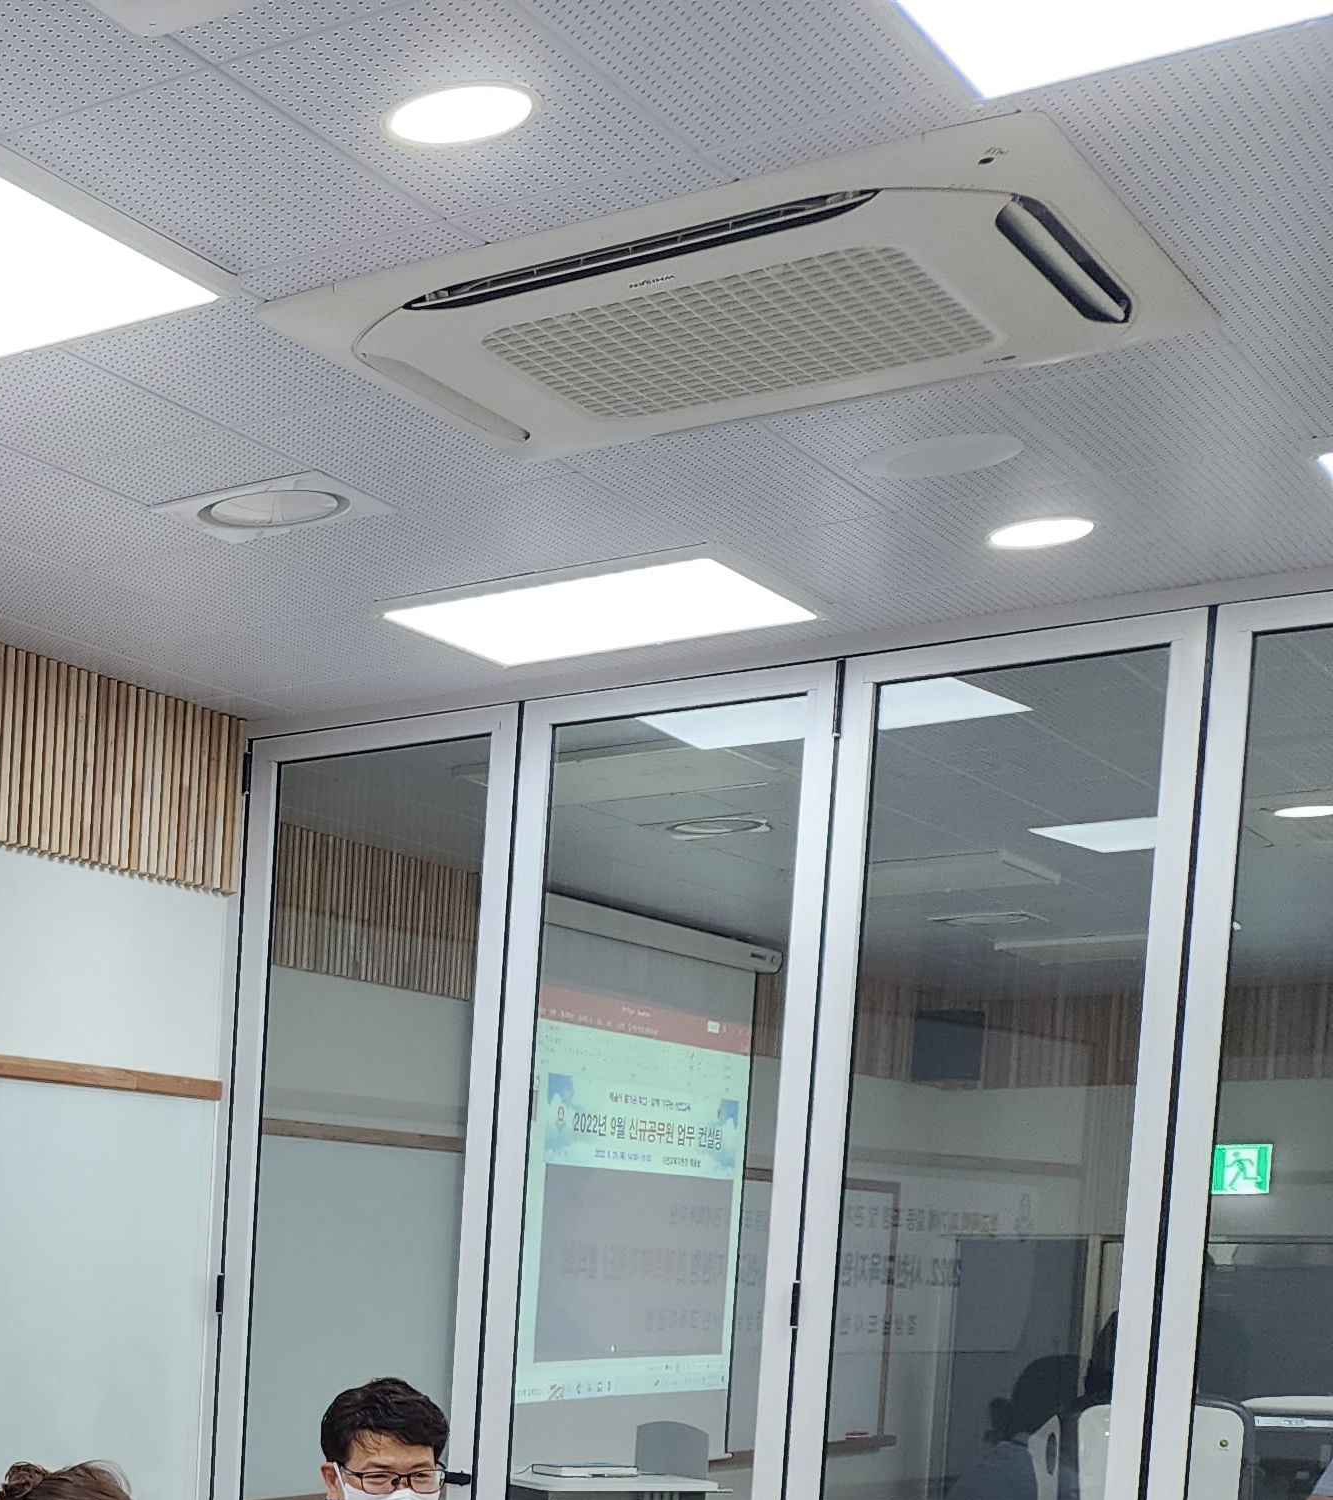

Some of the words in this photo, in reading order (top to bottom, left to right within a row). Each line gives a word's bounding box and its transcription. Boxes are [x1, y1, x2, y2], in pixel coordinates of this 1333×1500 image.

[573, 1112, 607, 1137] 2022년
[610, 1116, 626, 1140] 9월
[629, 1118, 674, 1144] 신규공무원
[677, 1123, 696, 1148] 업무
[698, 1126, 723, 1151] 컨설팅
